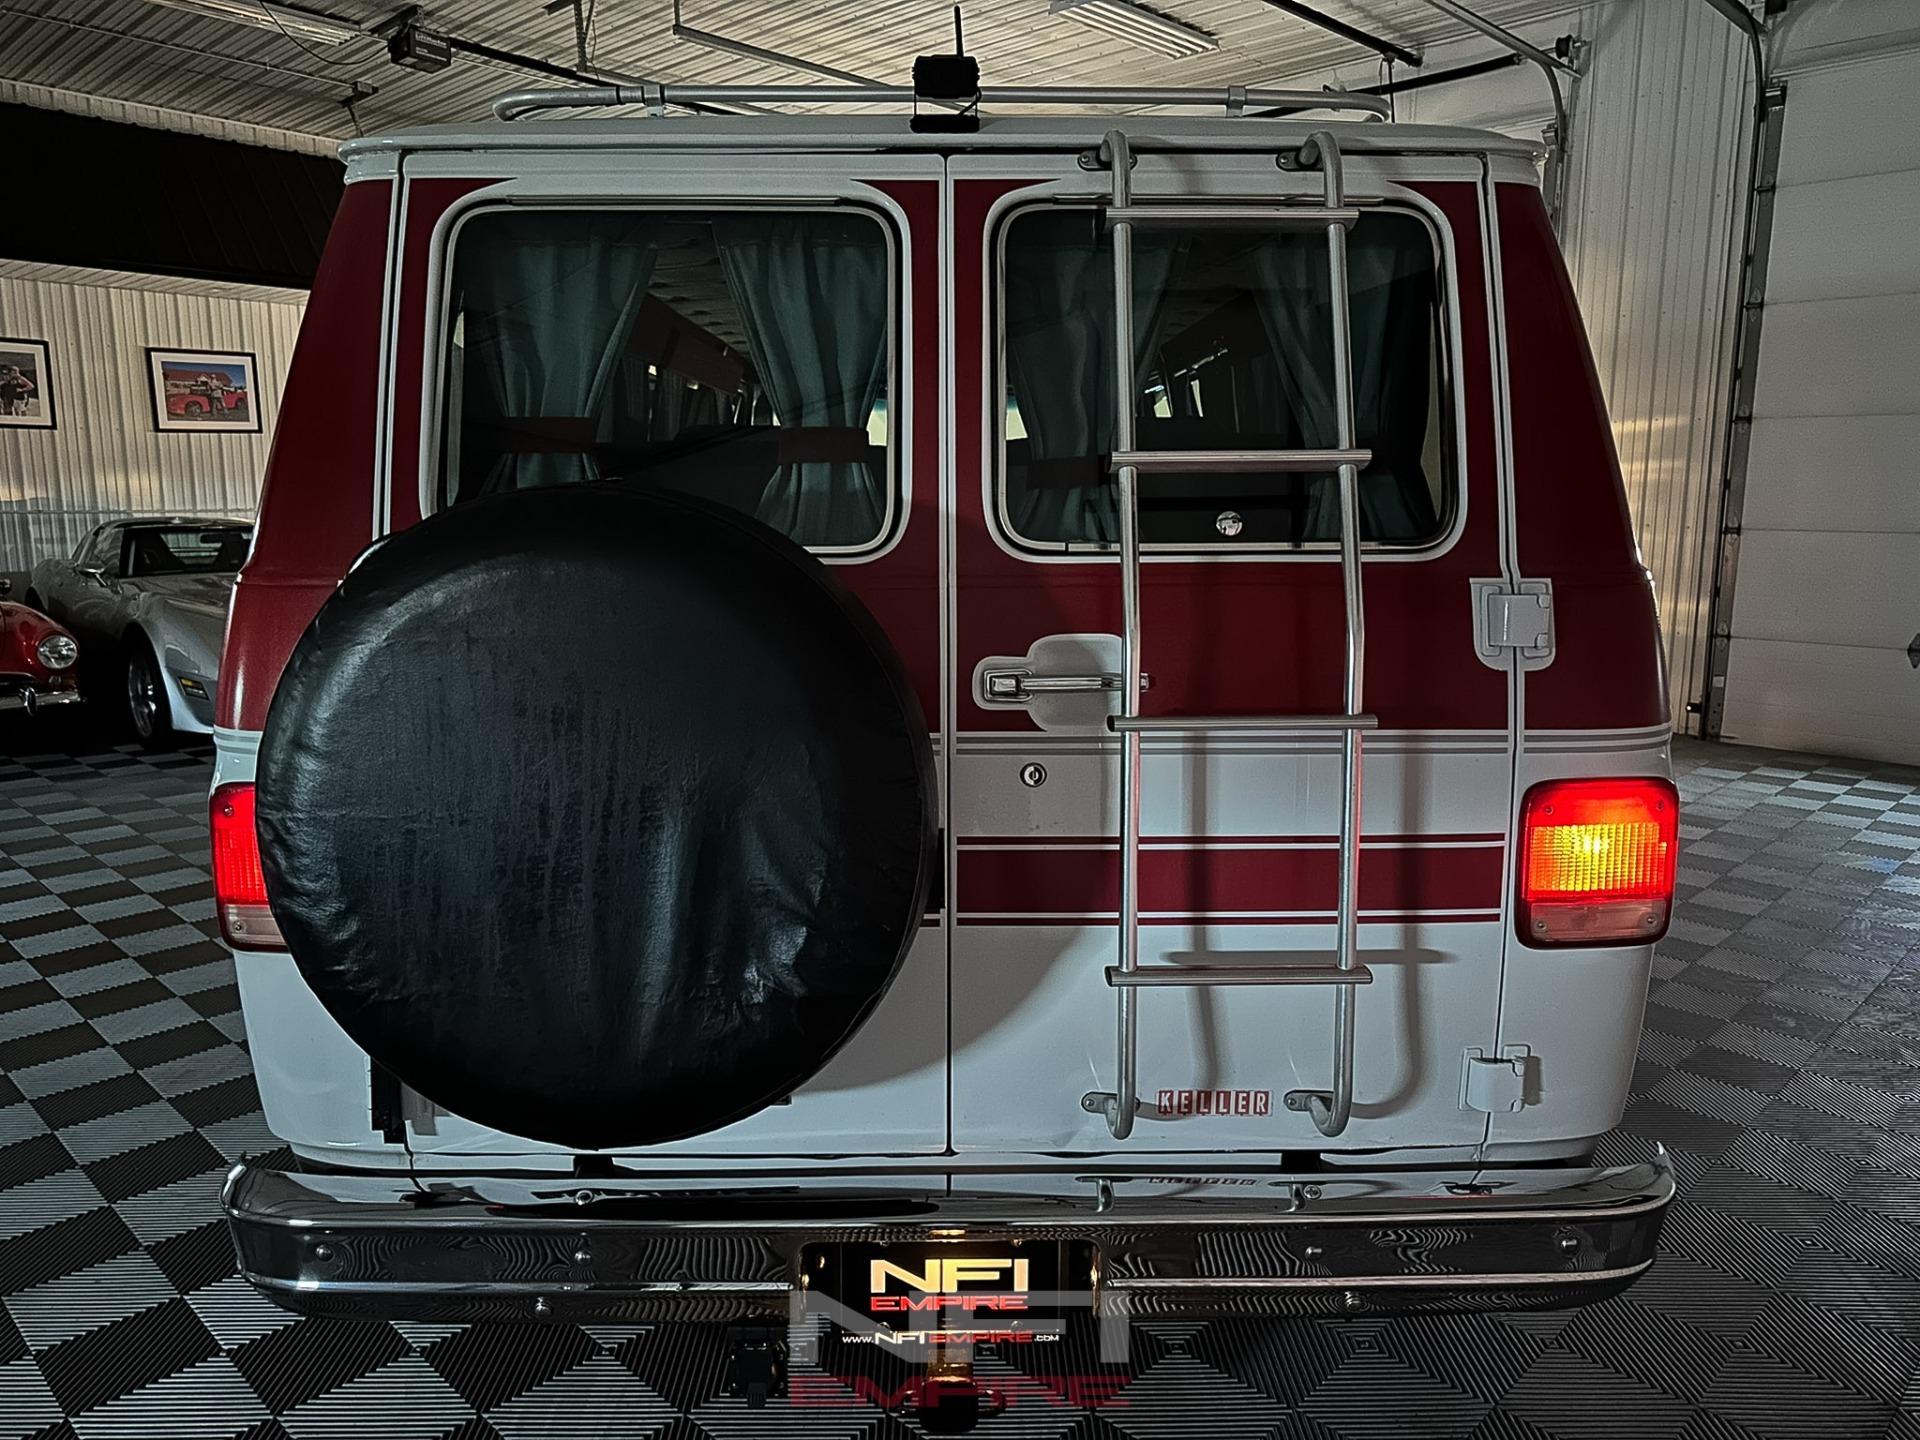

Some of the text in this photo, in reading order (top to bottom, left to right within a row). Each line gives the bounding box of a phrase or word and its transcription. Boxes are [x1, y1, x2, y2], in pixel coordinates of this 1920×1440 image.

[1159, 1092, 1268, 1113] KELLER
[870, 1258, 1029, 1293] NFI
[870, 1295, 1028, 1311] EMPIRE
